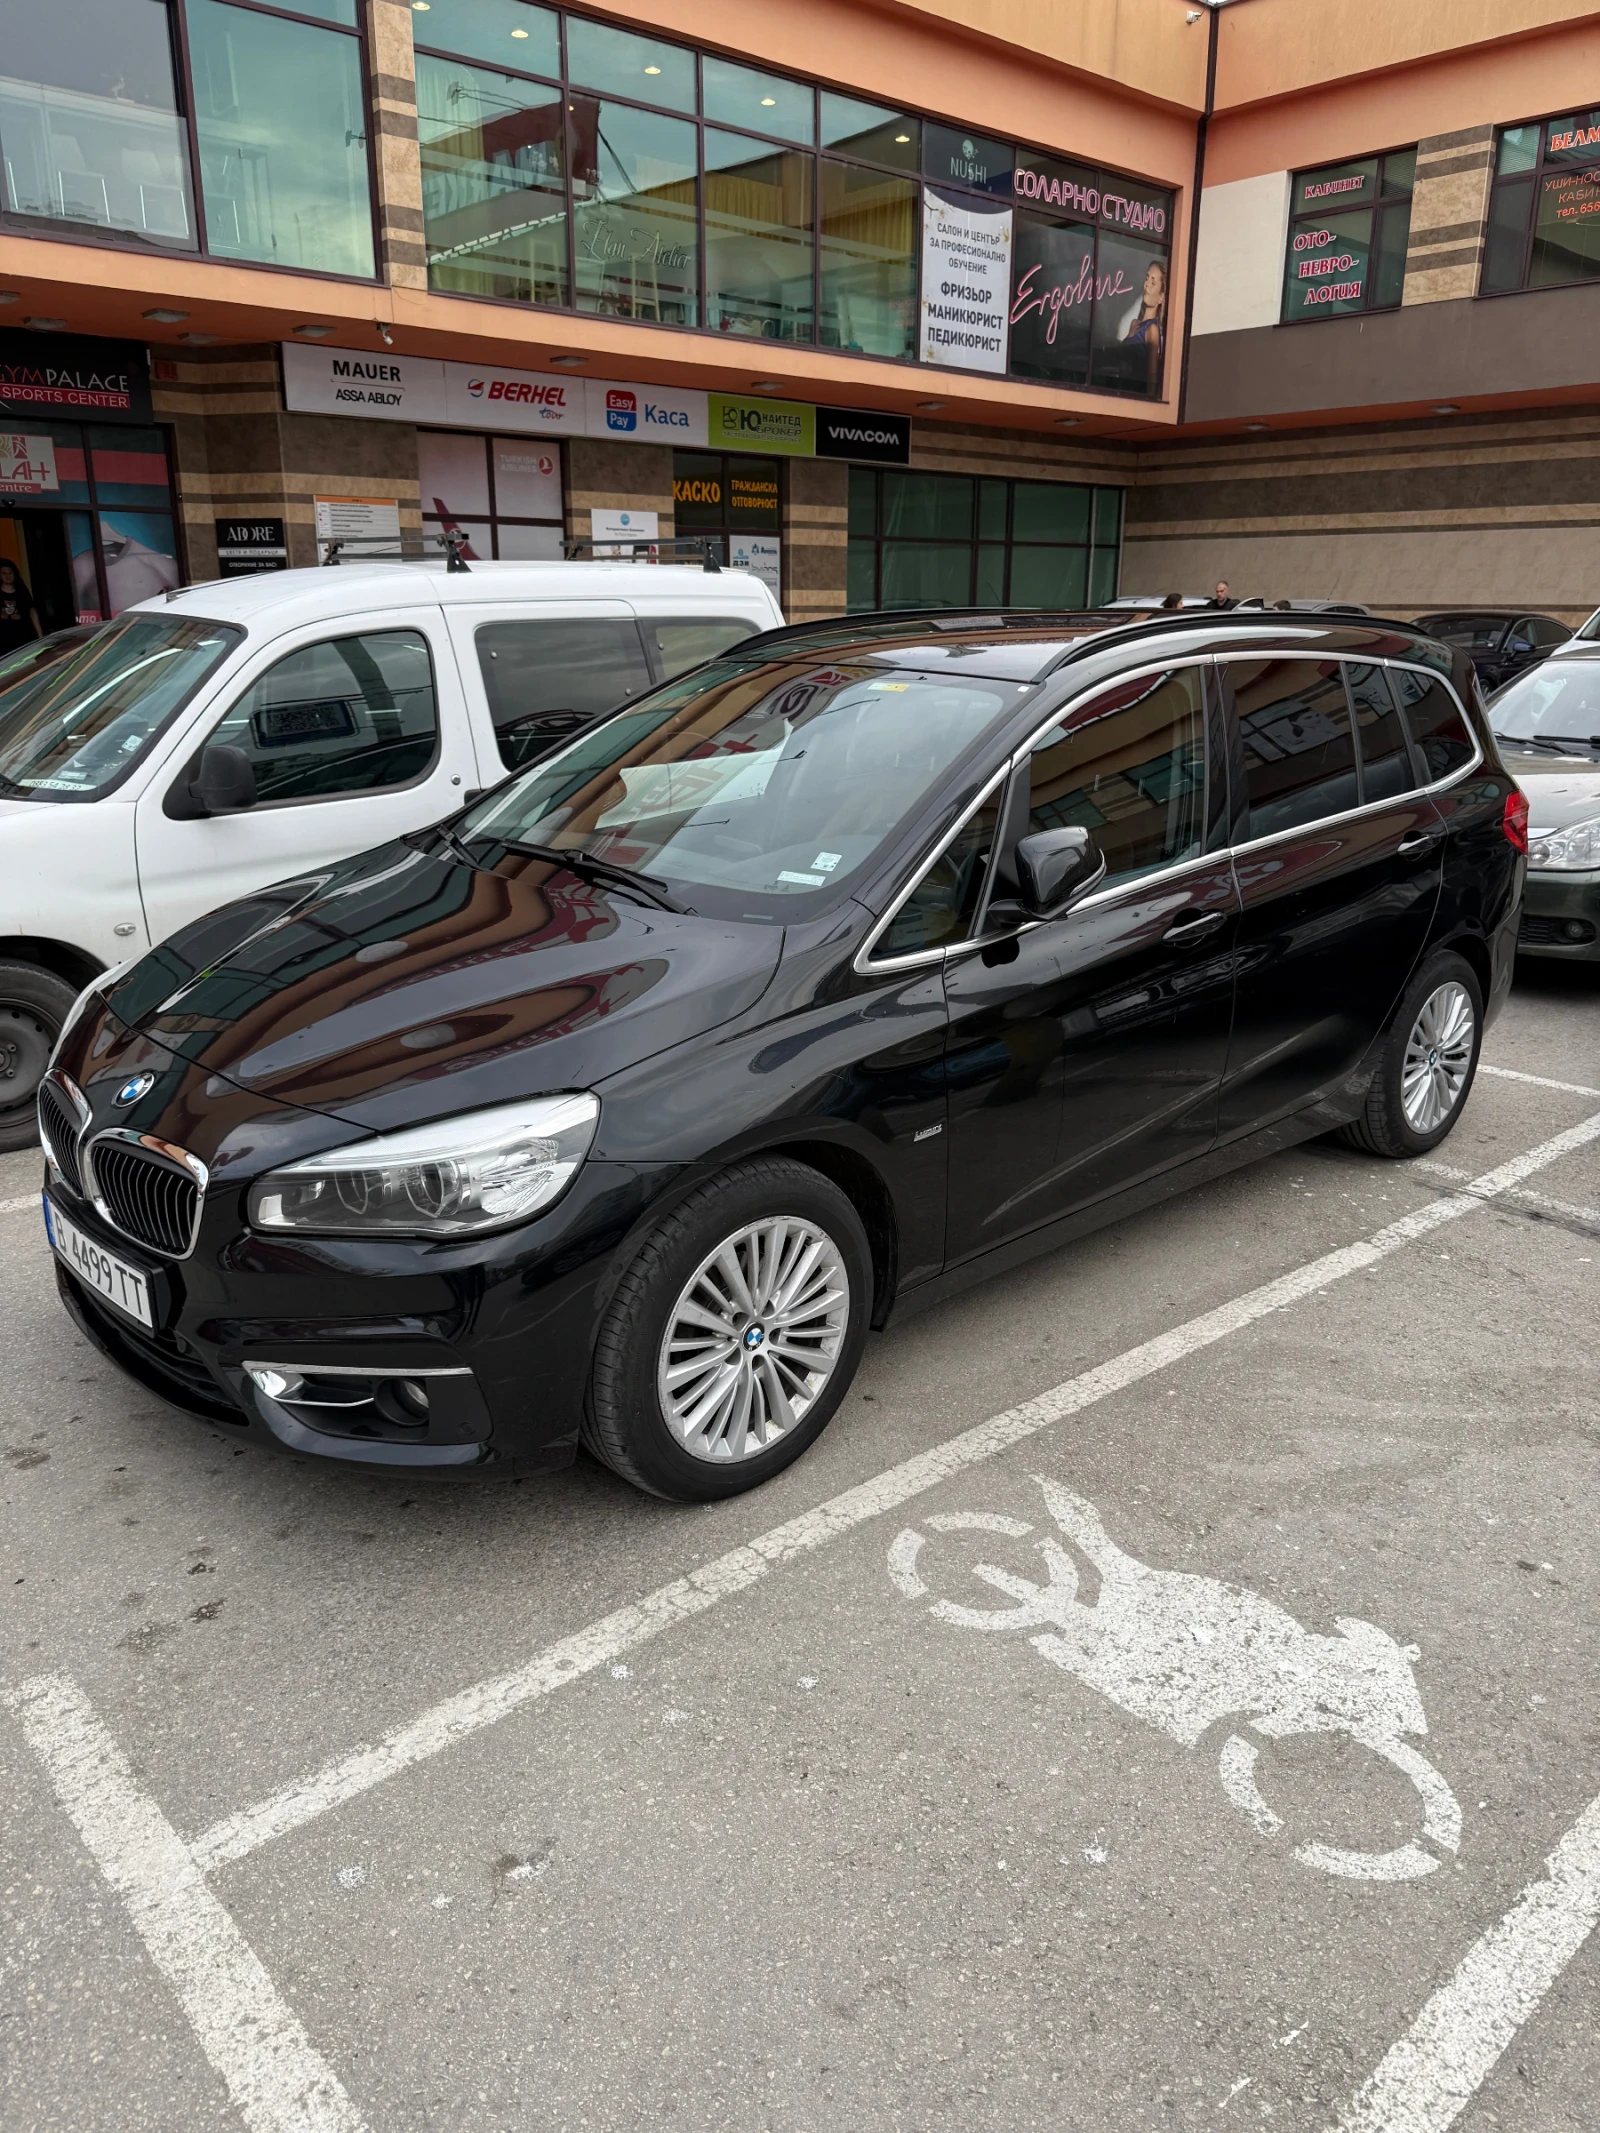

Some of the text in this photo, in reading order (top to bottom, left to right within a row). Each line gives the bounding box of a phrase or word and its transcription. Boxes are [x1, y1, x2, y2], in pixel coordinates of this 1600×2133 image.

[950, 157, 987, 184] NUSHI
[1305, 175, 1365, 199] КАБИНЕТ
[1014, 168, 1165, 232] СОЛАРНО СТУДИО
[1556, 207, 1578, 219] тел.
[937, 222, 1000, 246] САЛОН И ЦЕНТЪР
[1293, 230, 1337, 252] ОТО-
[929, 237, 1006, 264] ЗА ПРОФЕСИОНАЛНО
[948, 257, 987, 275] ОБУЧЕНИЕ
[1298, 255, 1360, 279] НЕВРО-
[940, 281, 992, 304] ФРИЗЬОР
[1303, 281, 1362, 305] ЛОГИЯ
[927, 302, 1003, 330] МАНИКЮРИСТ
[927, 326, 1002, 353] ПЕДИКЮРИСТ
[332, 360, 401, 382] MAUER
[2, 387, 128, 408] SPORTS CENTER
[335, 388, 402, 406] ASSA ABLOY
[488, 381, 567, 407] BERHEL
[609, 394, 634, 411] Easy
[610, 412, 629, 428] Pay
[645, 404, 689, 427] Каса
[740, 409, 801, 432] ЮНАЙТЕД
[756, 425, 802, 437] БРОКЕР
[828, 425, 900, 446] VIVACOM
[500, 454, 536, 465] TURKISH
[500, 463, 538, 473] AIRLINES
[672, 480, 720, 504] КАСКО
[732, 480, 778, 493] ГРАЖДАНСКА
[732, 496, 777, 509] ОТГОВОРНОСТ
[227, 526, 275, 541] ADORE
[54, 1211, 143, 1316] B 4499 TT
